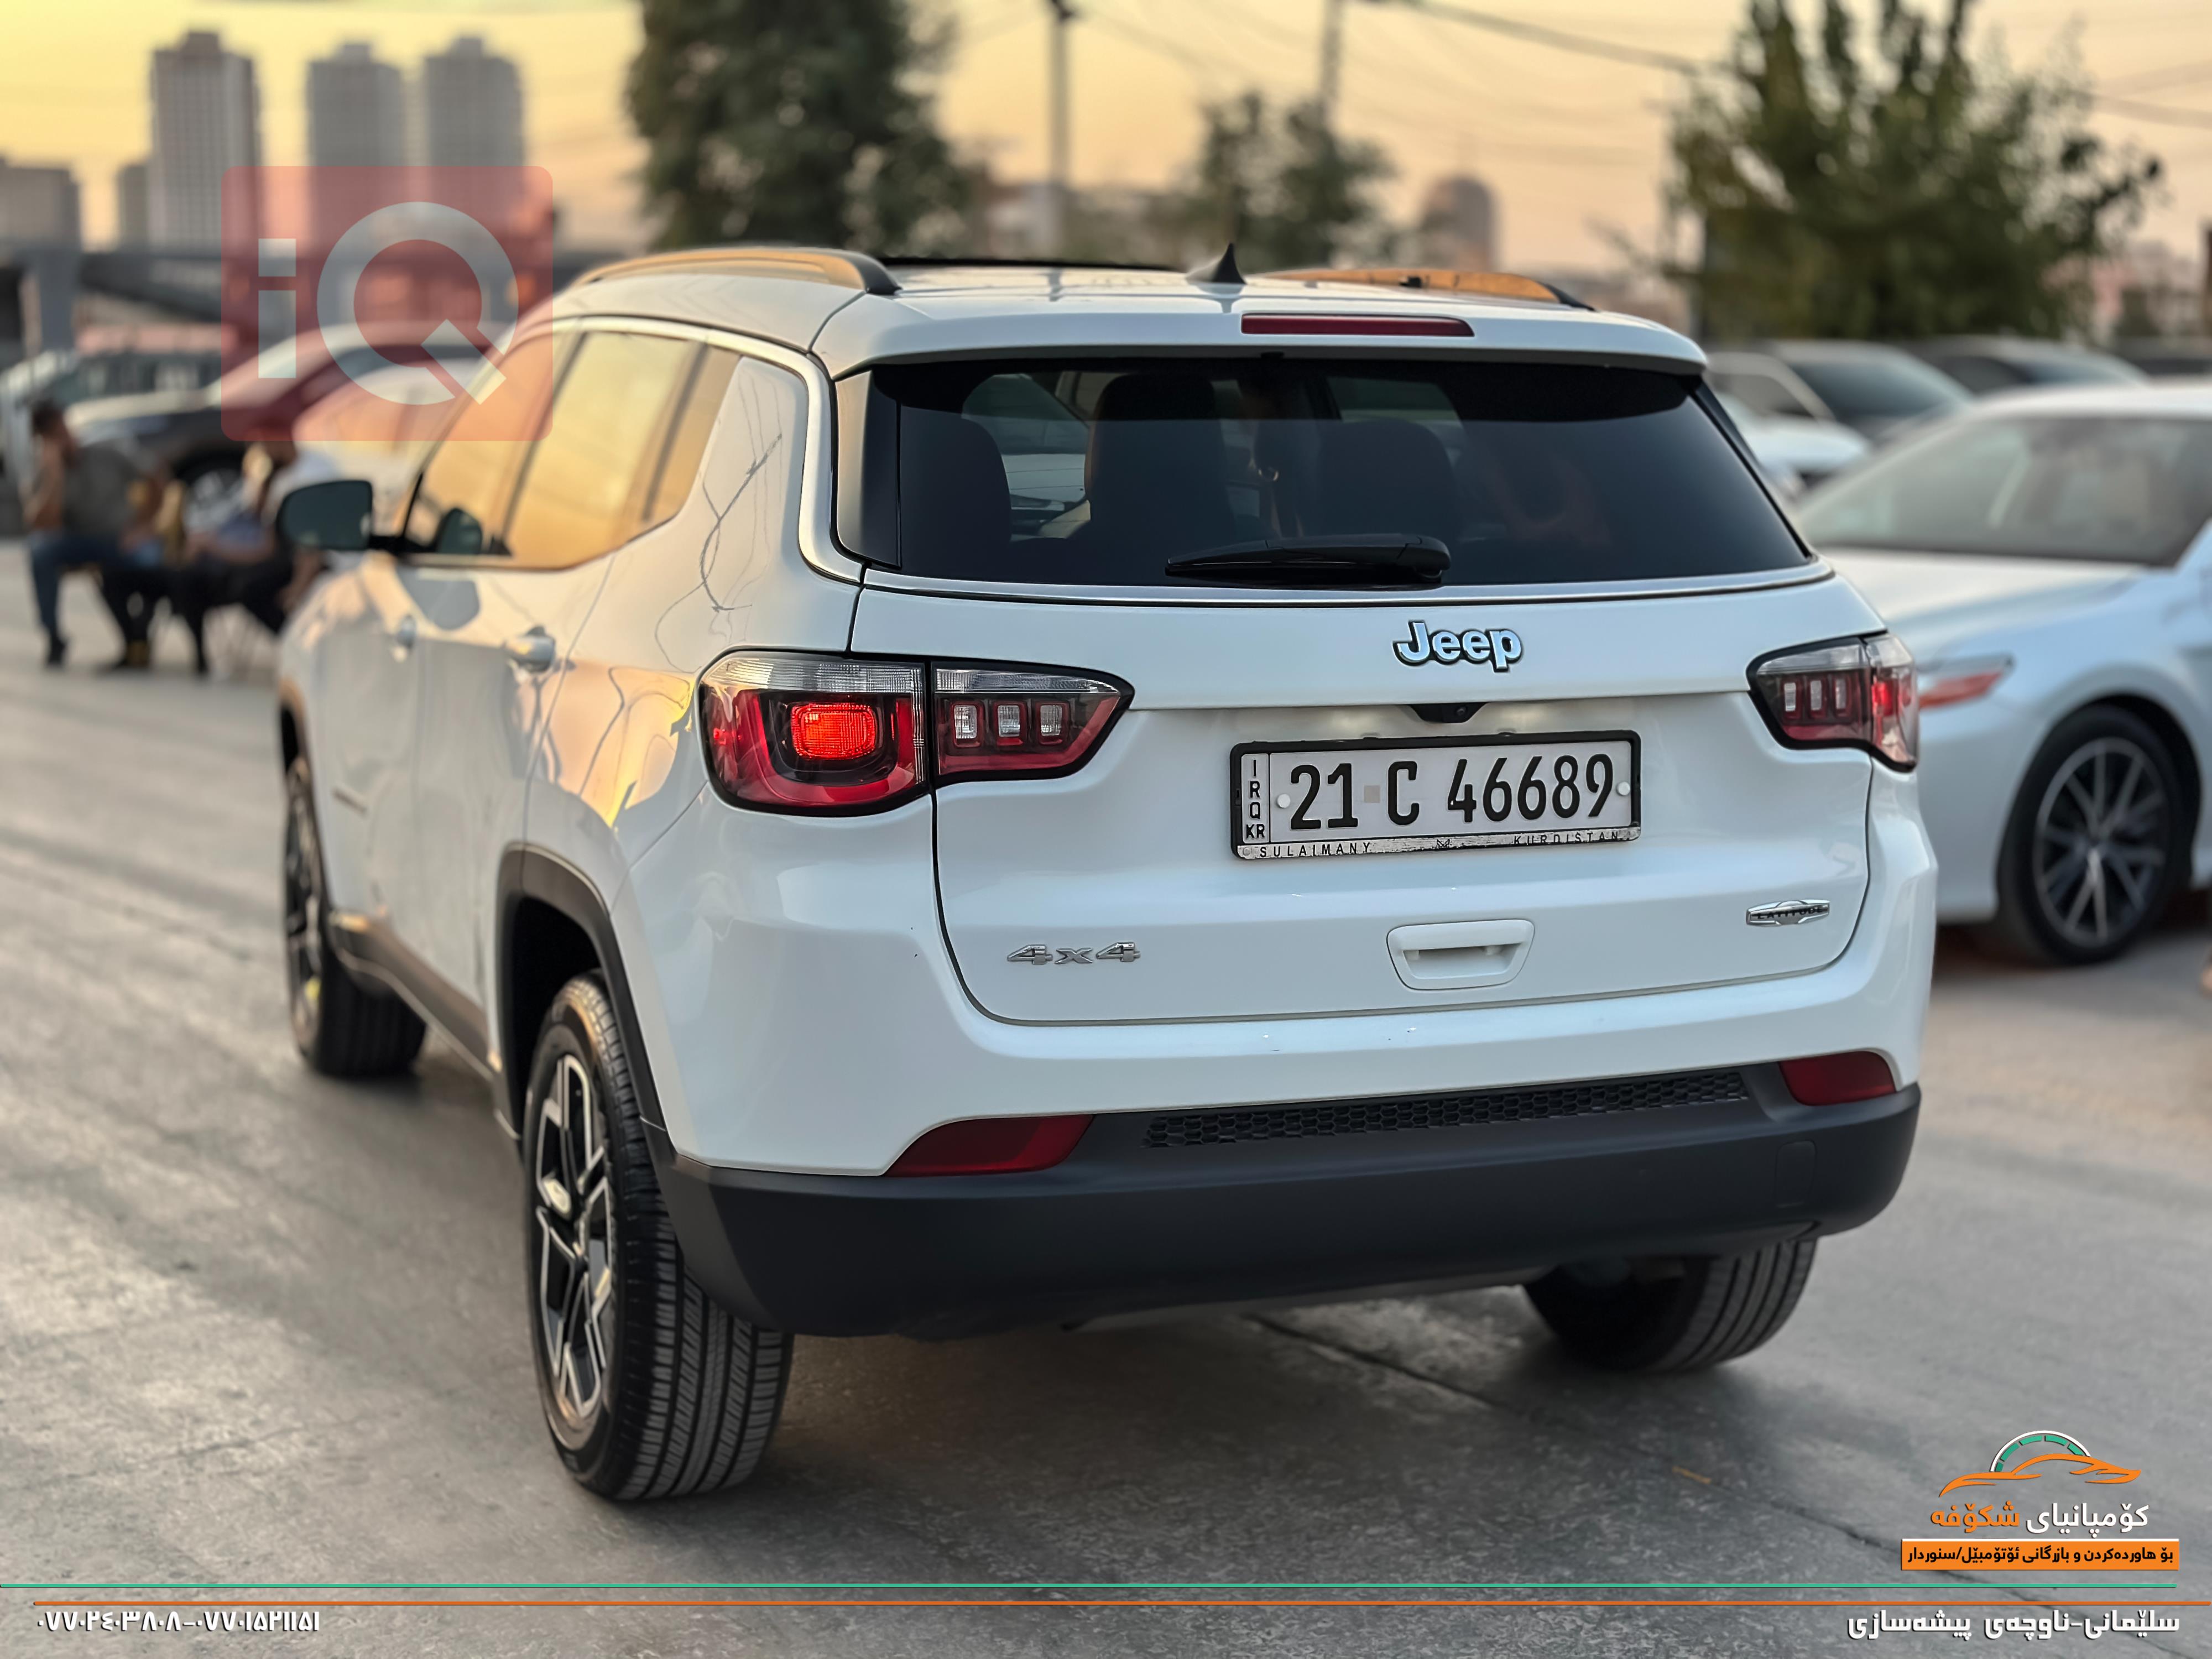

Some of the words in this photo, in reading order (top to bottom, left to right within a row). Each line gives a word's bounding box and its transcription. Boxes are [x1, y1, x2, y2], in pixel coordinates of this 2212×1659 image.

[1393, 620, 1522, 672] Jeep
[1290, 763, 1359, 830] 21
[1387, 761, 1420, 826] C
[1447, 753, 1614, 823] 46689
[1260, 842, 1371, 858] SULAIMANY
[1514, 831, 1618, 846] KURDISTAN
